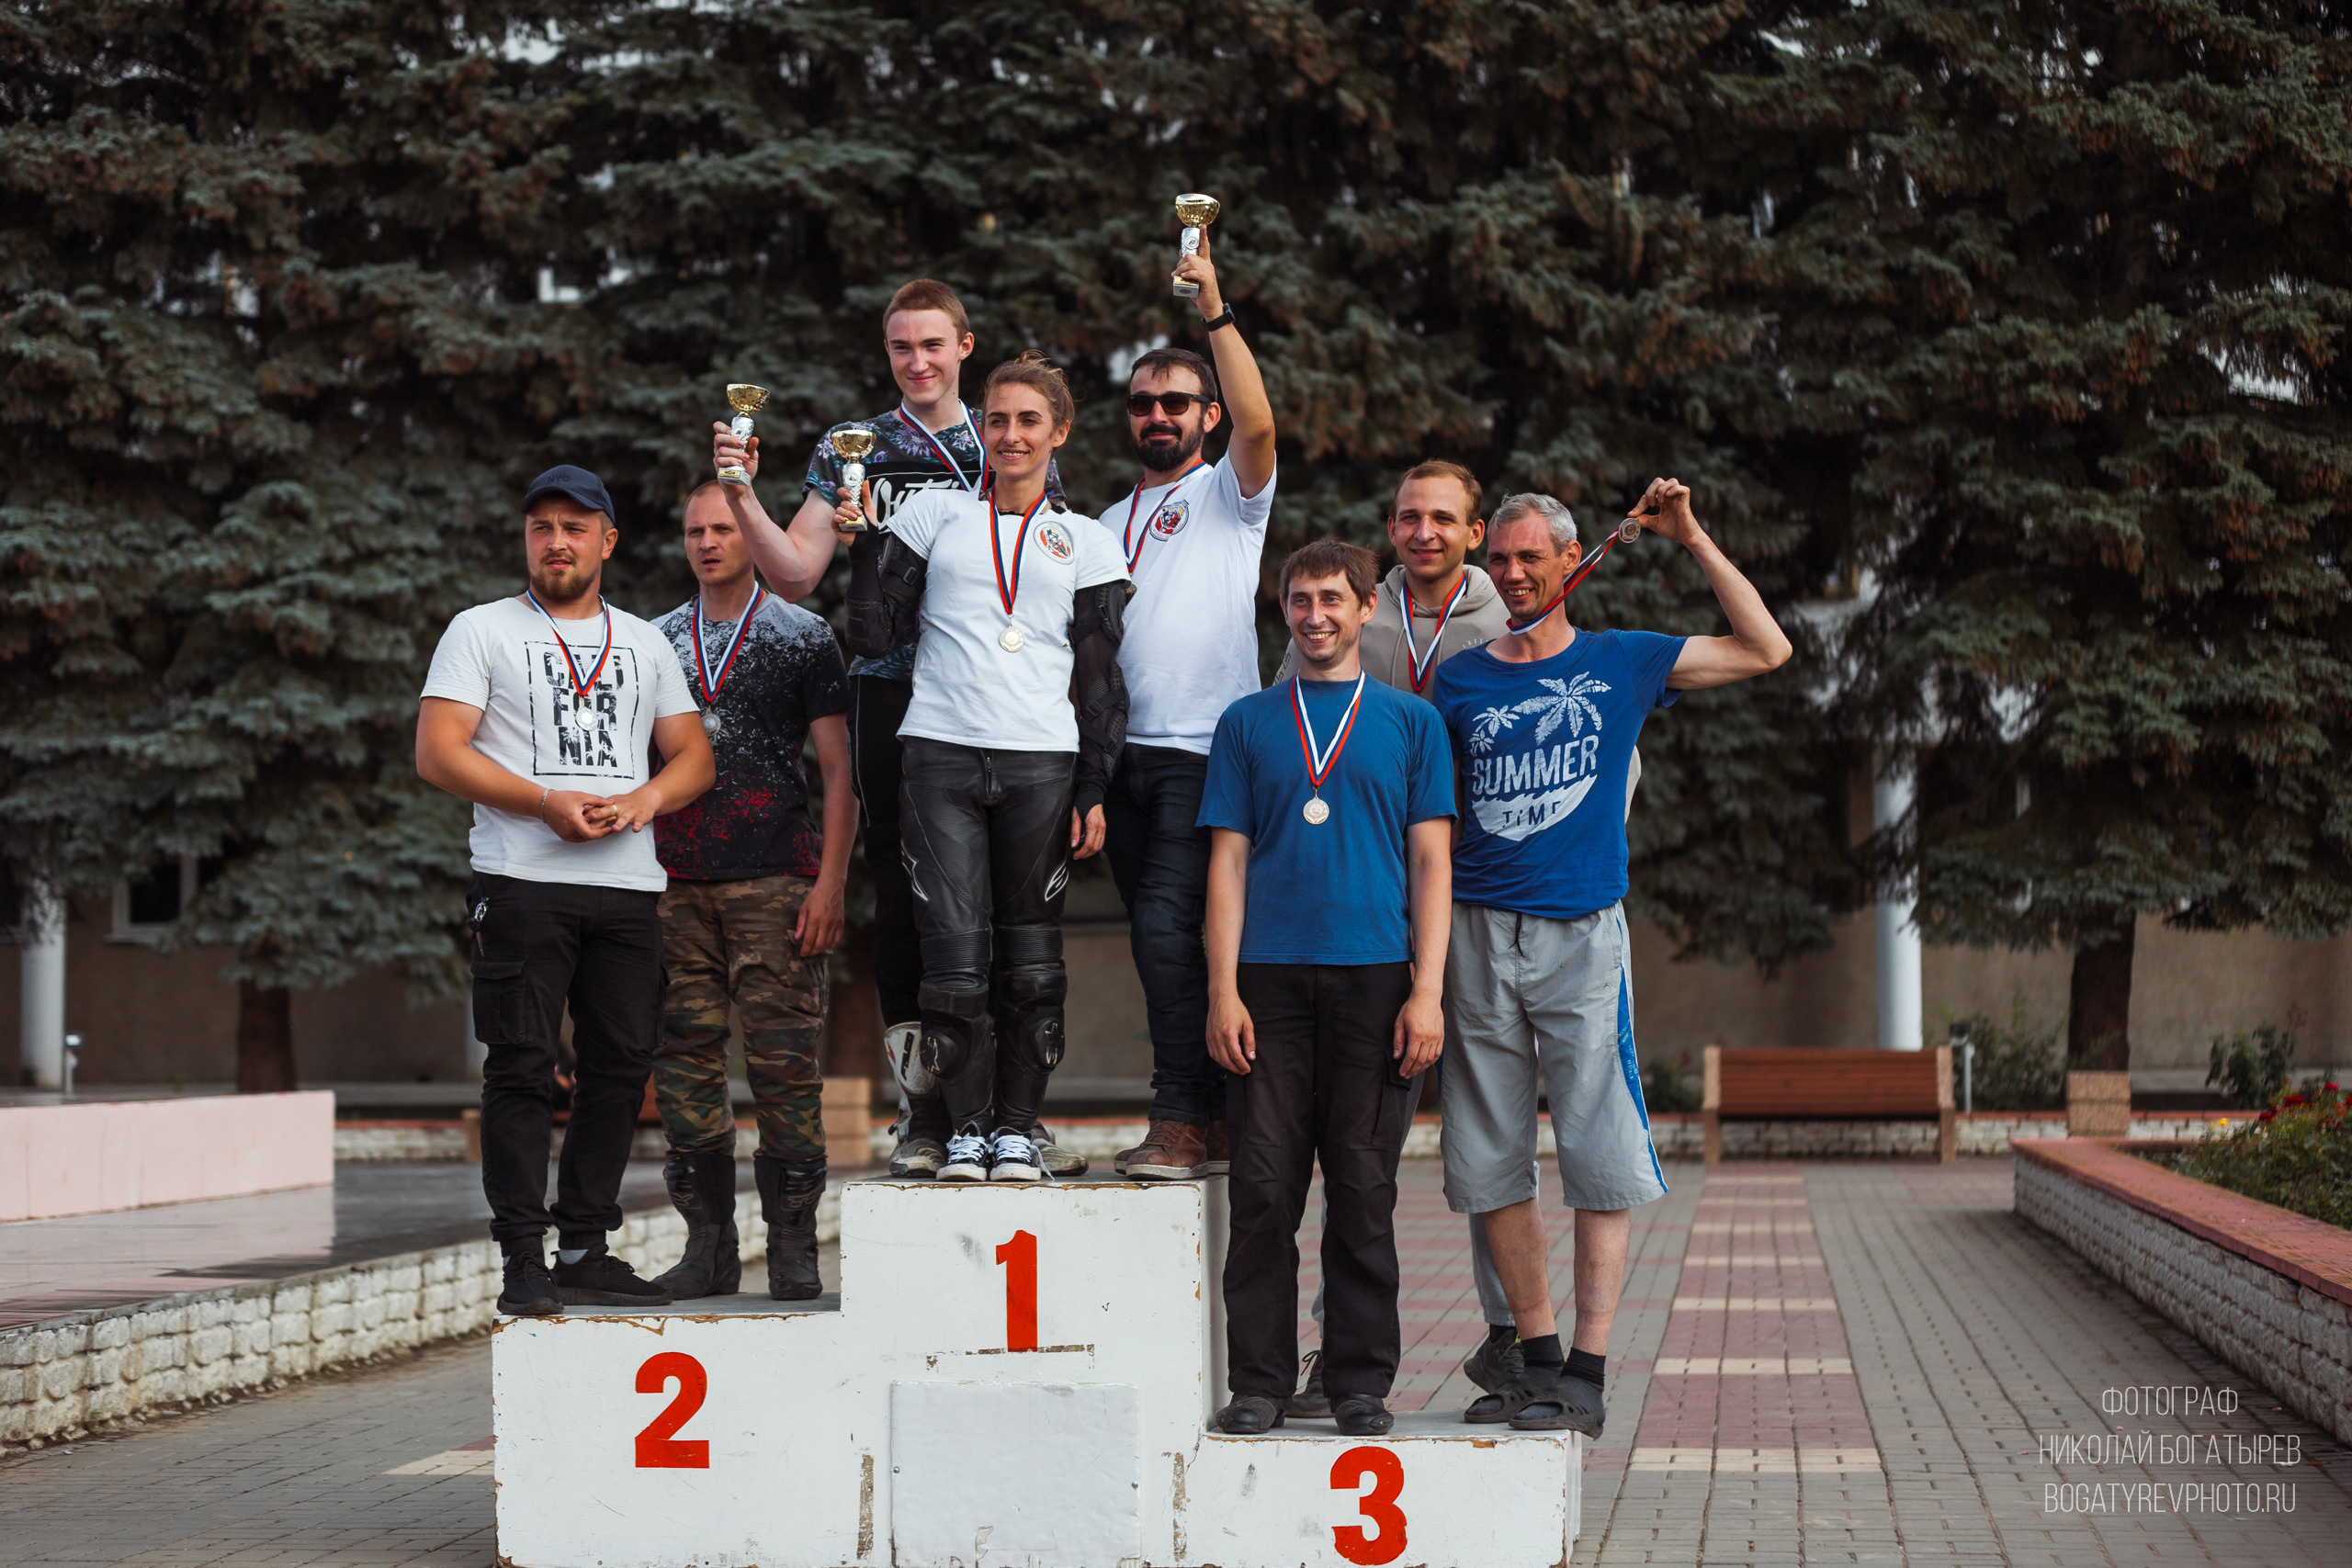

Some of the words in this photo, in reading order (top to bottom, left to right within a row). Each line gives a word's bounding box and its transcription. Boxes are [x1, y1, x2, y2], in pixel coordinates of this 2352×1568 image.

[559, 727, 617, 768] NIA
[1472, 735, 1600, 796] SUMMER
[996, 1229, 1038, 1352] 1
[634, 1352, 710, 1468] 2
[1329, 1446, 1408, 1565] 3
